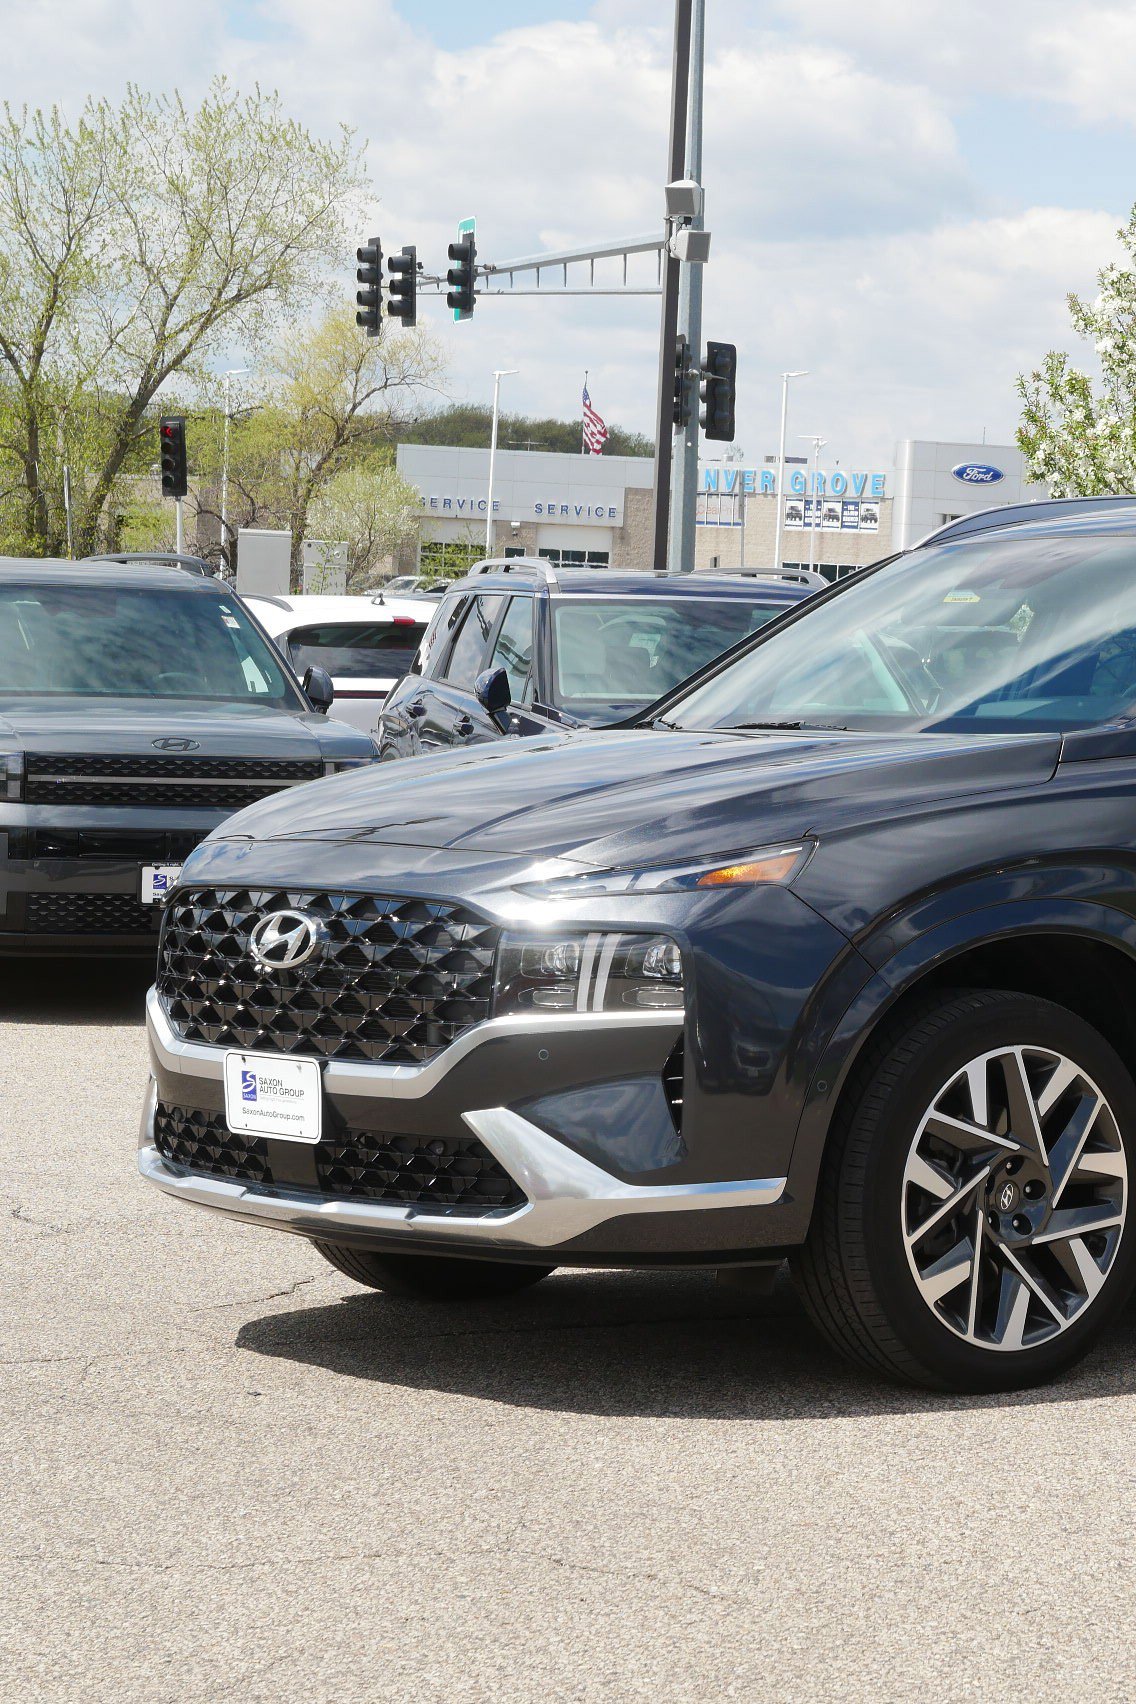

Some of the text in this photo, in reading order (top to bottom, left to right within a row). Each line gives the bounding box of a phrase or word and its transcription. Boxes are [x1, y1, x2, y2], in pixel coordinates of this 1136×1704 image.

[963, 467, 993, 480] Ford
[703, 468, 885, 497] NVER GROVE
[419, 497, 500, 511] SERVICE
[534, 503, 617, 518] SERVICE
[258, 1077, 283, 1087] SAXON
[259, 1086, 305, 1097] AUTO GROUP
[242, 1107, 305, 1121] SaxonAutoGroup.com
